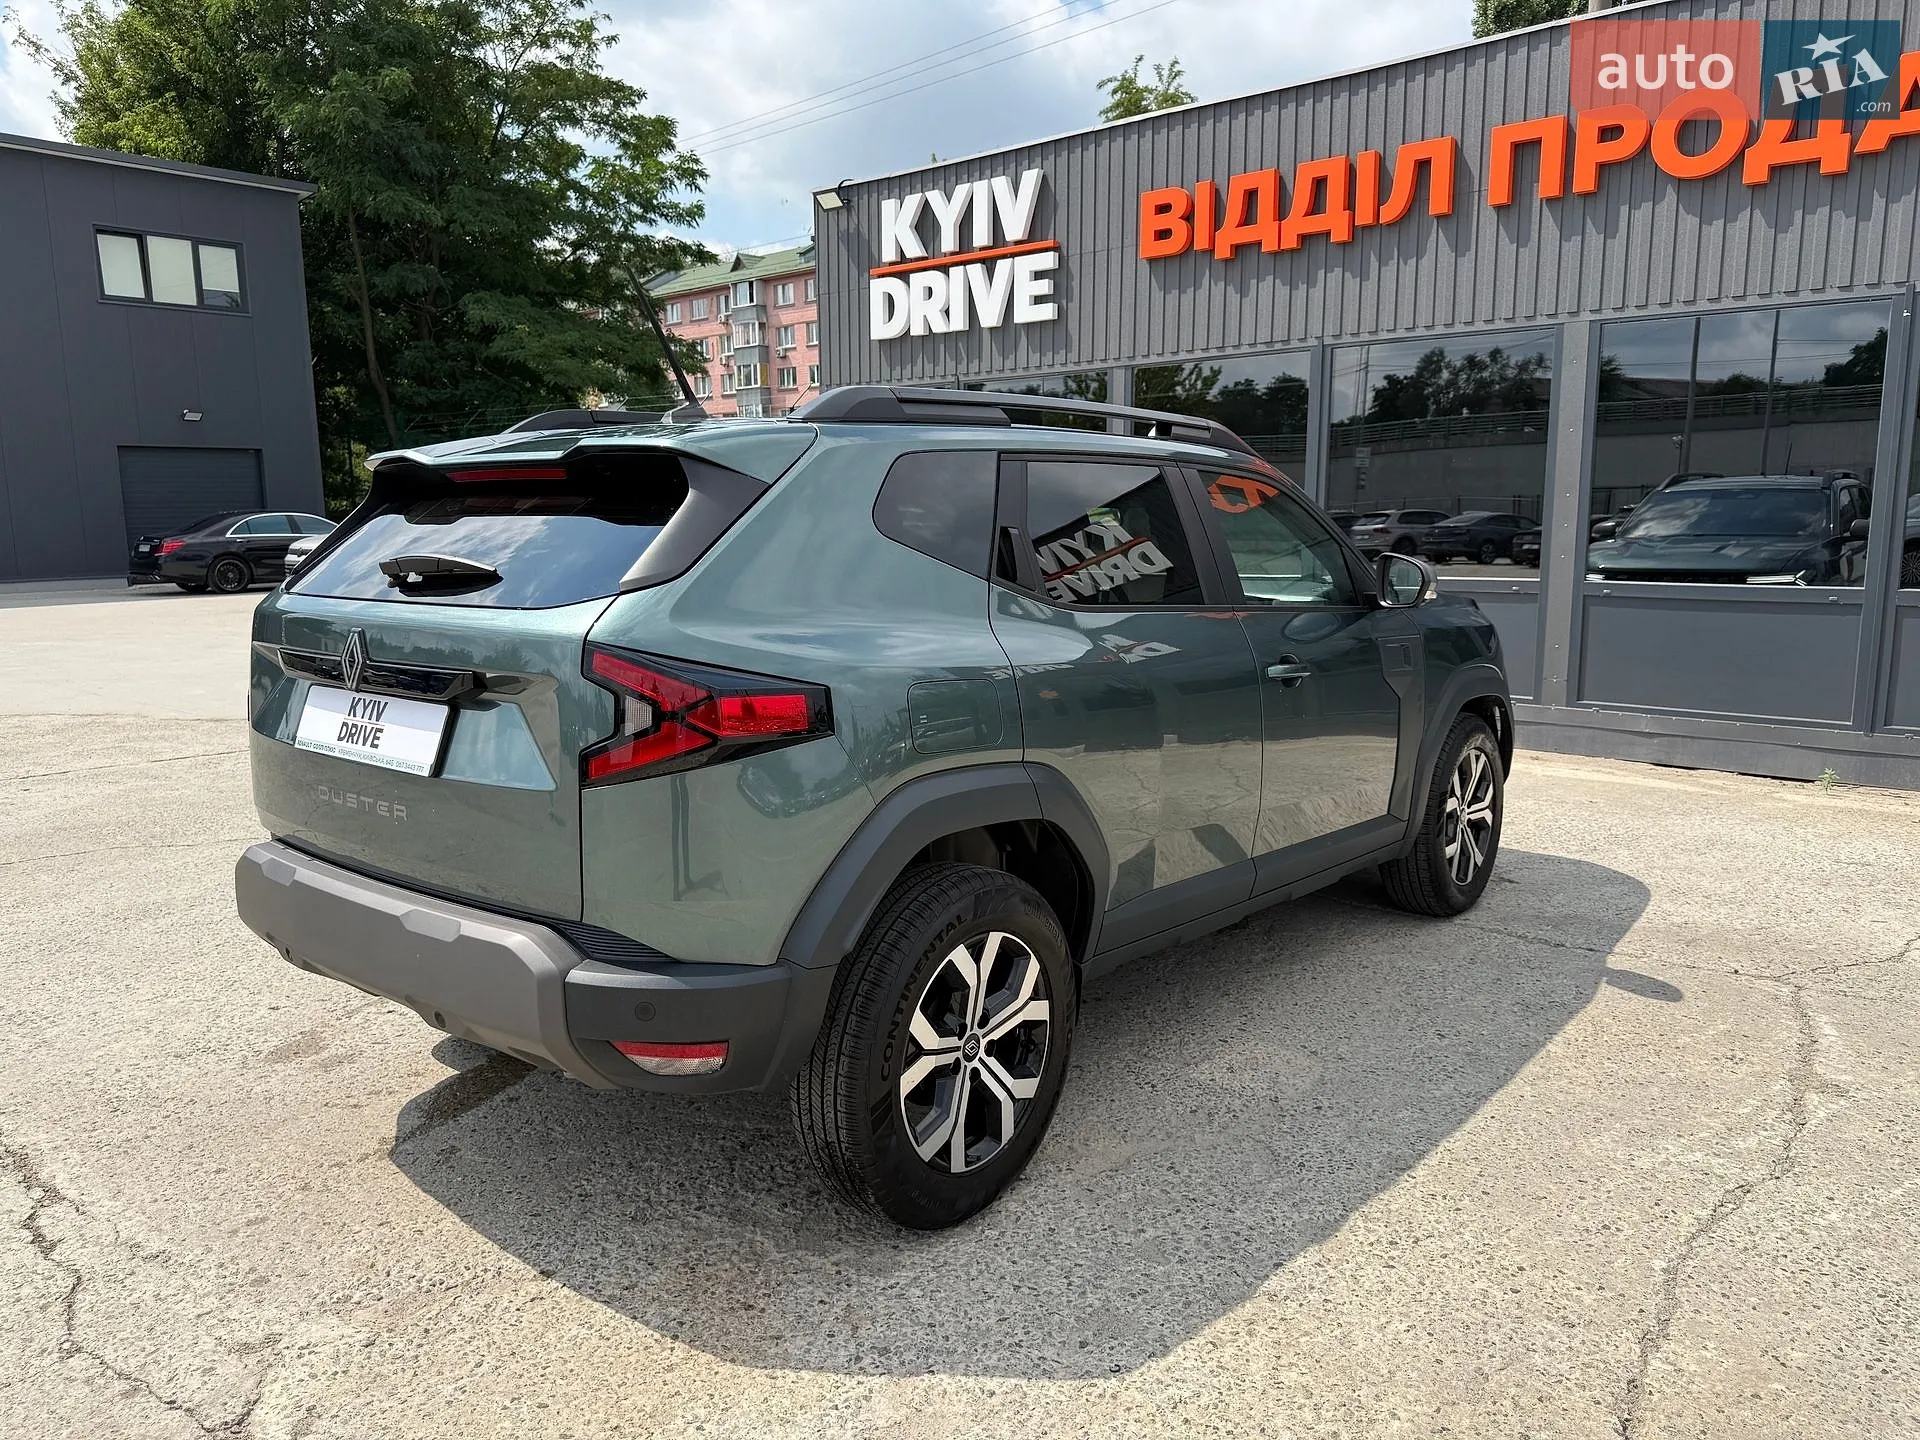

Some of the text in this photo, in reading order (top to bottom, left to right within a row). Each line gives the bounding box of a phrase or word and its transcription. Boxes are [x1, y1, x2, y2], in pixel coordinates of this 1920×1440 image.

[881, 168, 1044, 263] KYIV
[1140, 135, 1455, 260] ВІДДІЛ
[869, 251, 1059, 341] DRIVE
[337, 721, 384, 749] DRIVE
[347, 696, 389, 722] KYIV
[318, 785, 408, 821] DUSTER
[881, 914, 967, 1082] CONTINENTAL
